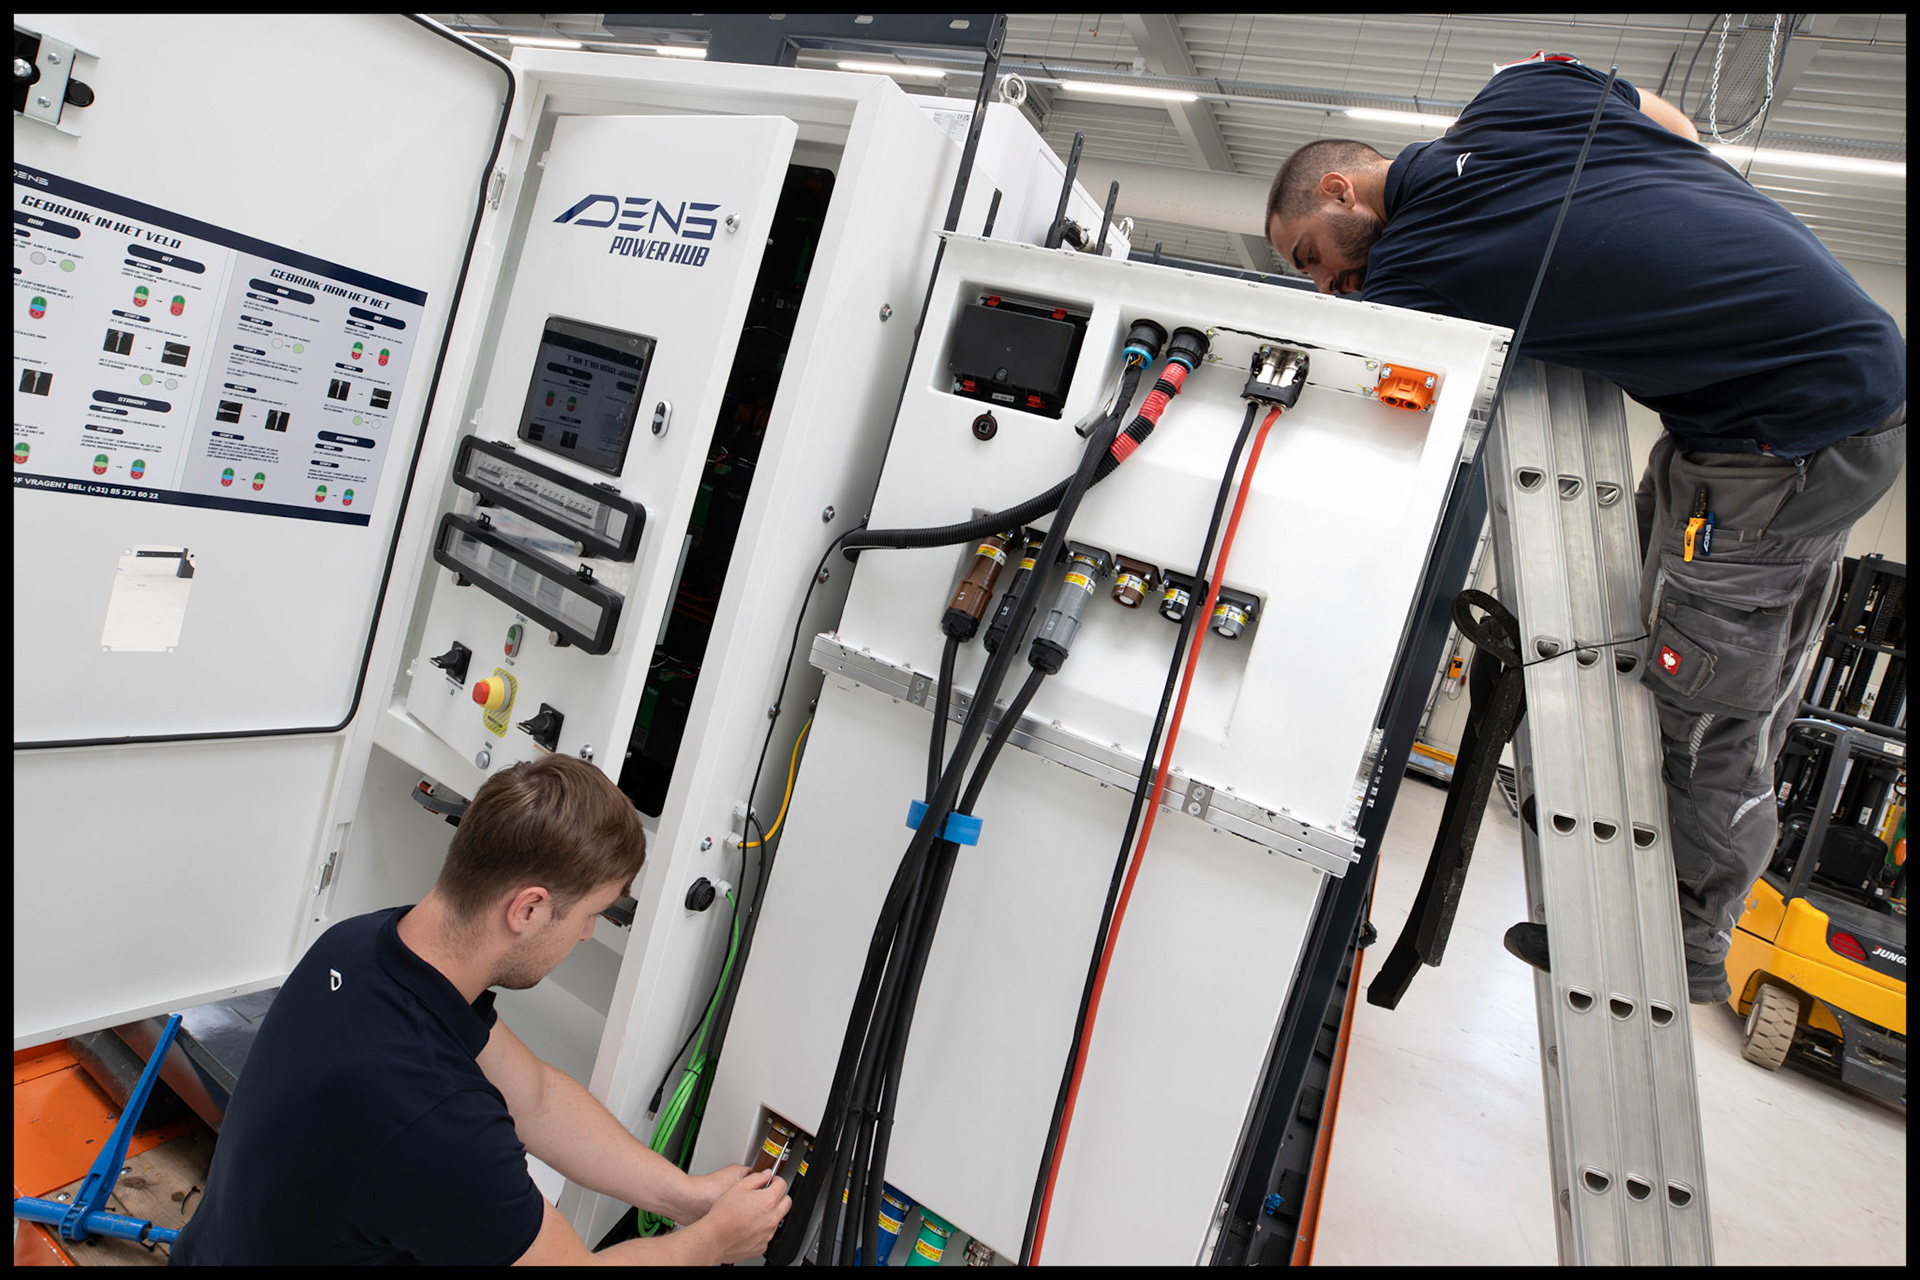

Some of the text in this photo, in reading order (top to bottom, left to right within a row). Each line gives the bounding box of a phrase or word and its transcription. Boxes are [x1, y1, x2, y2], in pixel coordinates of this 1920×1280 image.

[21, 195, 182, 249] GEBRUIK IN HET VELD
[552, 194, 722, 241] DENS
[609, 236, 710, 268] POWER HUB
[270, 268, 391, 310] GEBRUIK AAN HET NET
[25, 478, 66, 488] VRAGEN?
[67, 483, 86, 491] BEL:
[88, 486, 108, 494] (+31)
[1703, 524, 1712, 552] DENS
[958, 592, 966, 600] L1
[1001, 606, 1010, 616] L2
[1872, 946, 1906, 966] JUNG
